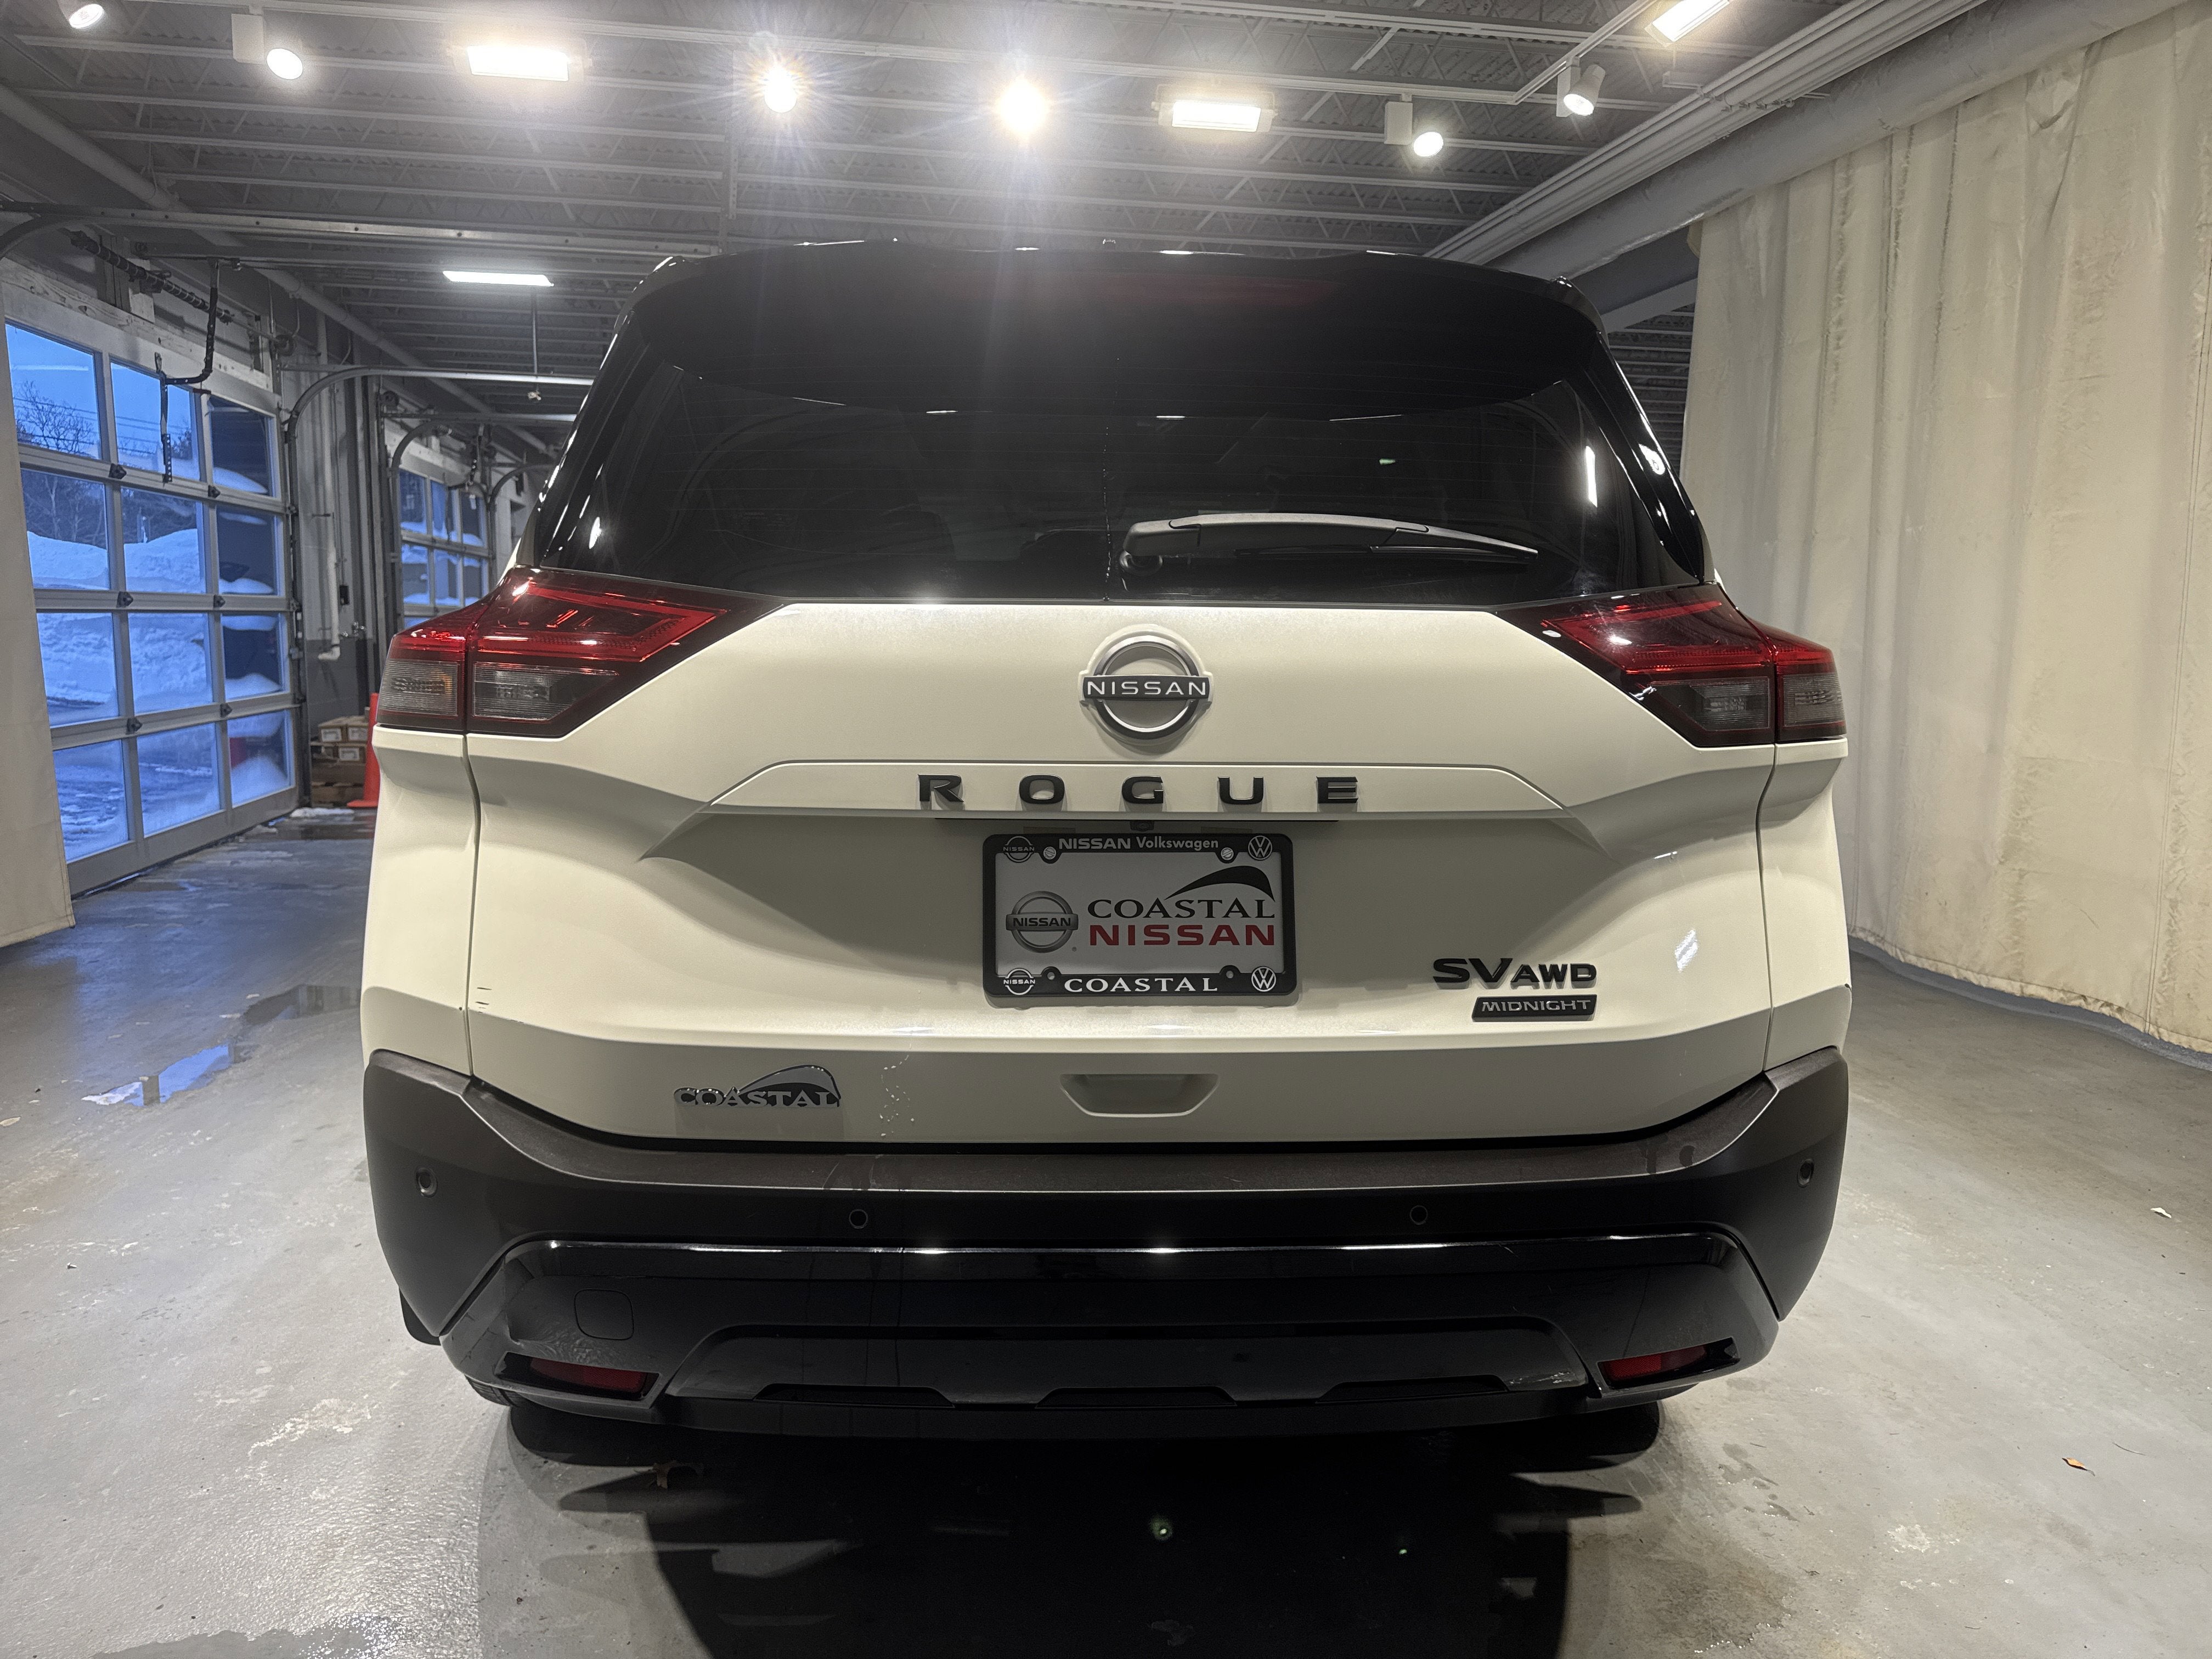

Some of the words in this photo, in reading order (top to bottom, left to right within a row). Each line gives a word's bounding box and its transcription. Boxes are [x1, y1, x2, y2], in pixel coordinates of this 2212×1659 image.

[1086, 679, 1207, 696] NISSAN
[918, 774, 1359, 805] ROGUE
[1059, 838, 1131, 849] NISSAN
[1136, 836, 1219, 851] Volkswagen
[1088, 897, 1276, 919] COASTAL
[1013, 917, 1071, 927] NISSAN
[1090, 924, 1275, 946] NISSAN
[1064, 977, 1218, 992] COASTAL
[1481, 999, 1591, 1012] MIDNIGHT
[673, 1086, 840, 1108] COASTAL
